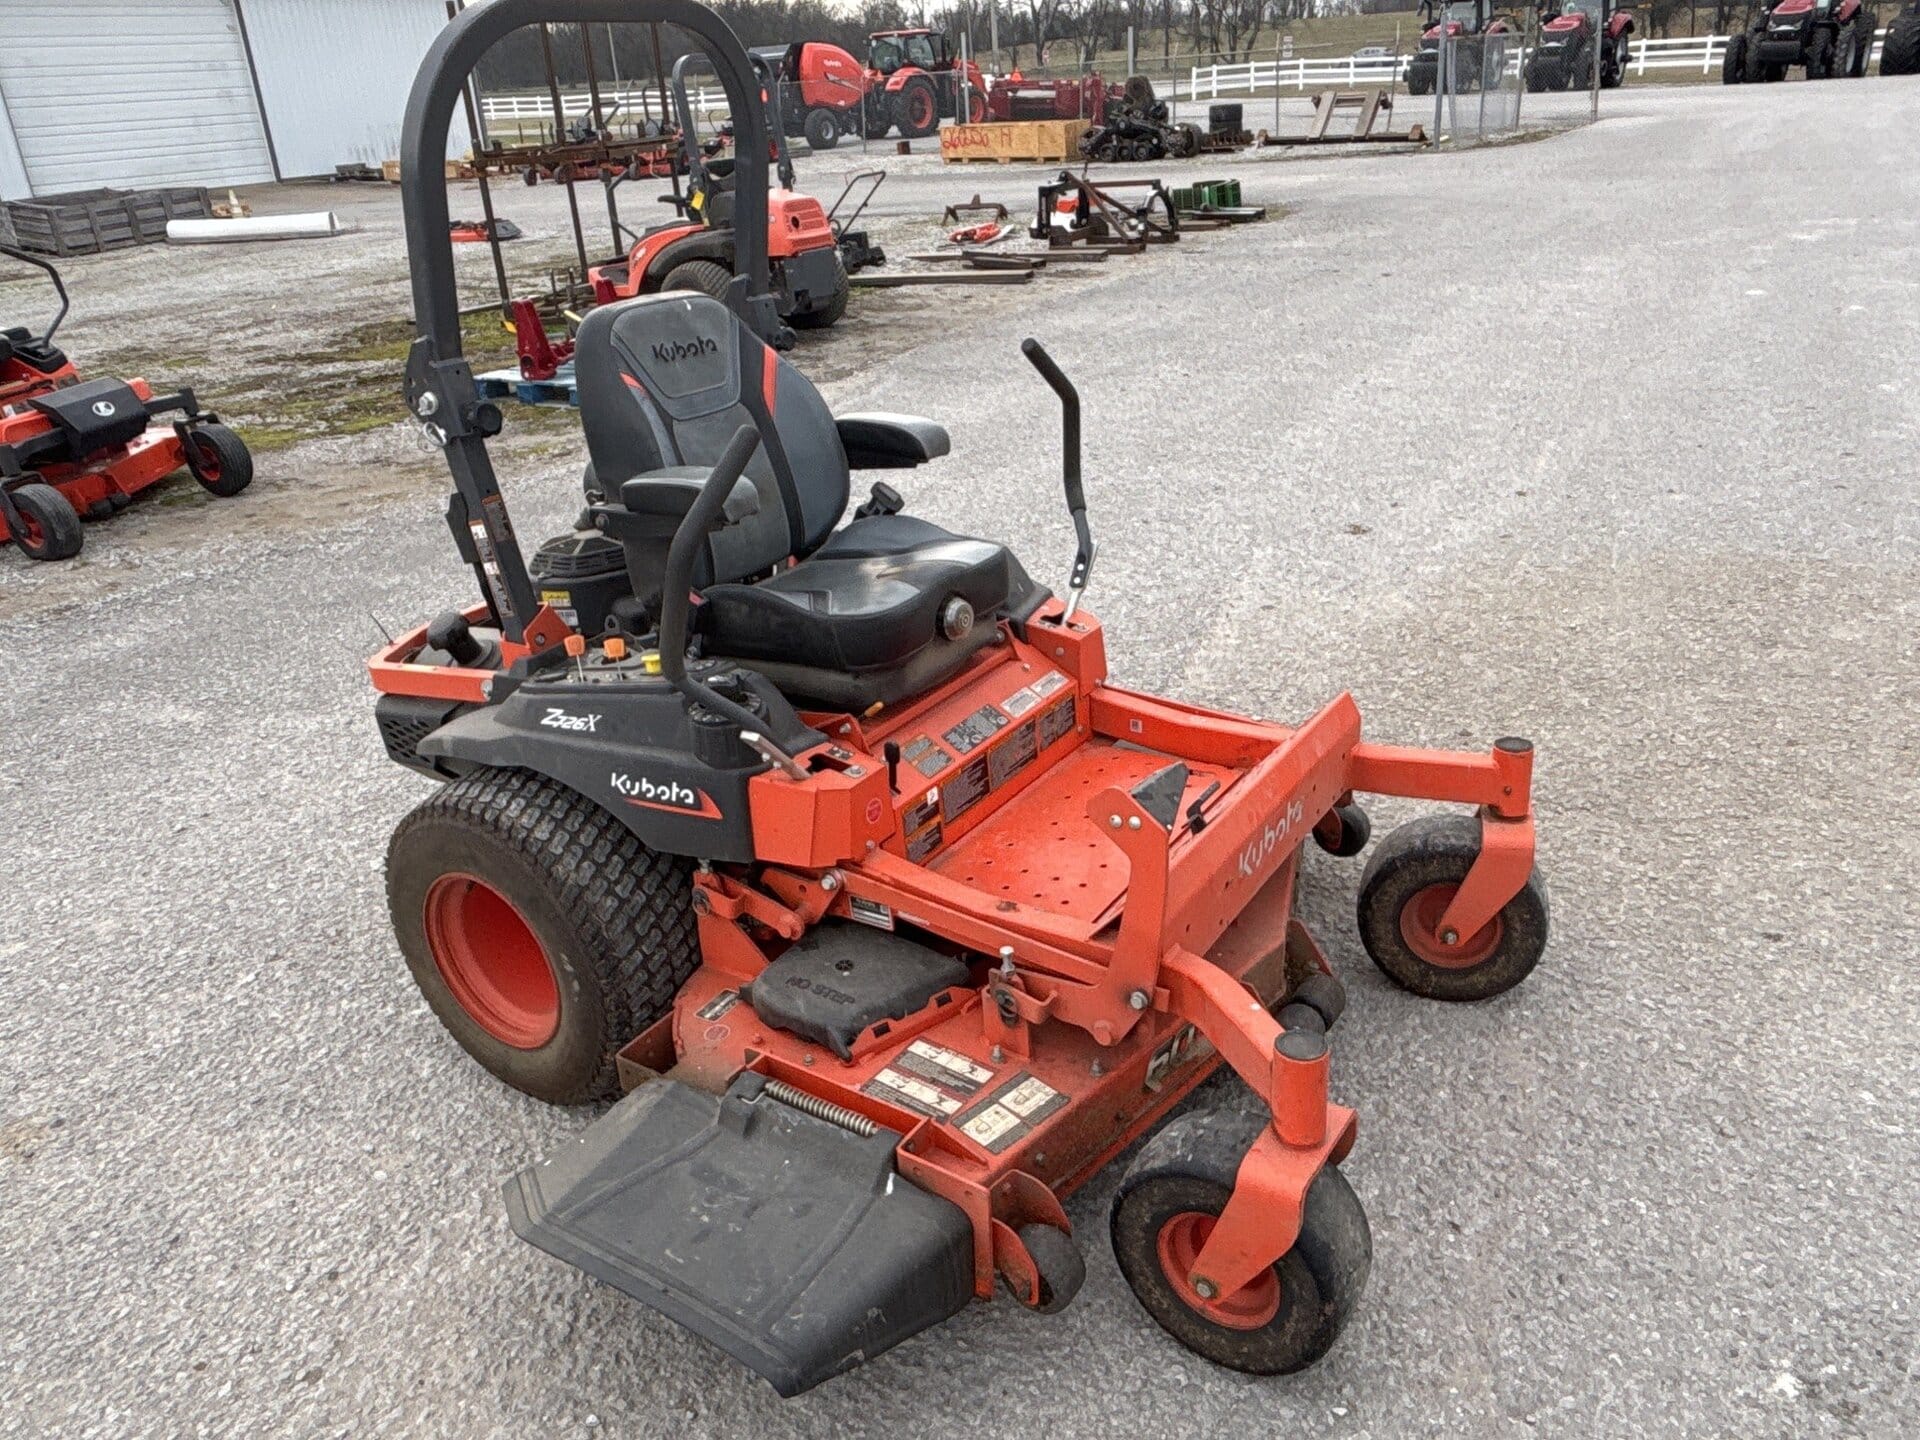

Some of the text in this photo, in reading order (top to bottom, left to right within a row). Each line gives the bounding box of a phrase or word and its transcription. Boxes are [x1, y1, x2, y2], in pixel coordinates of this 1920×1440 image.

[651, 335, 717, 363] Kubota
[540, 707, 602, 732] Z726X
[610, 772, 694, 805] Kubota
[1239, 800, 1303, 877] Kubota
[785, 976, 856, 1005] NO STEP
